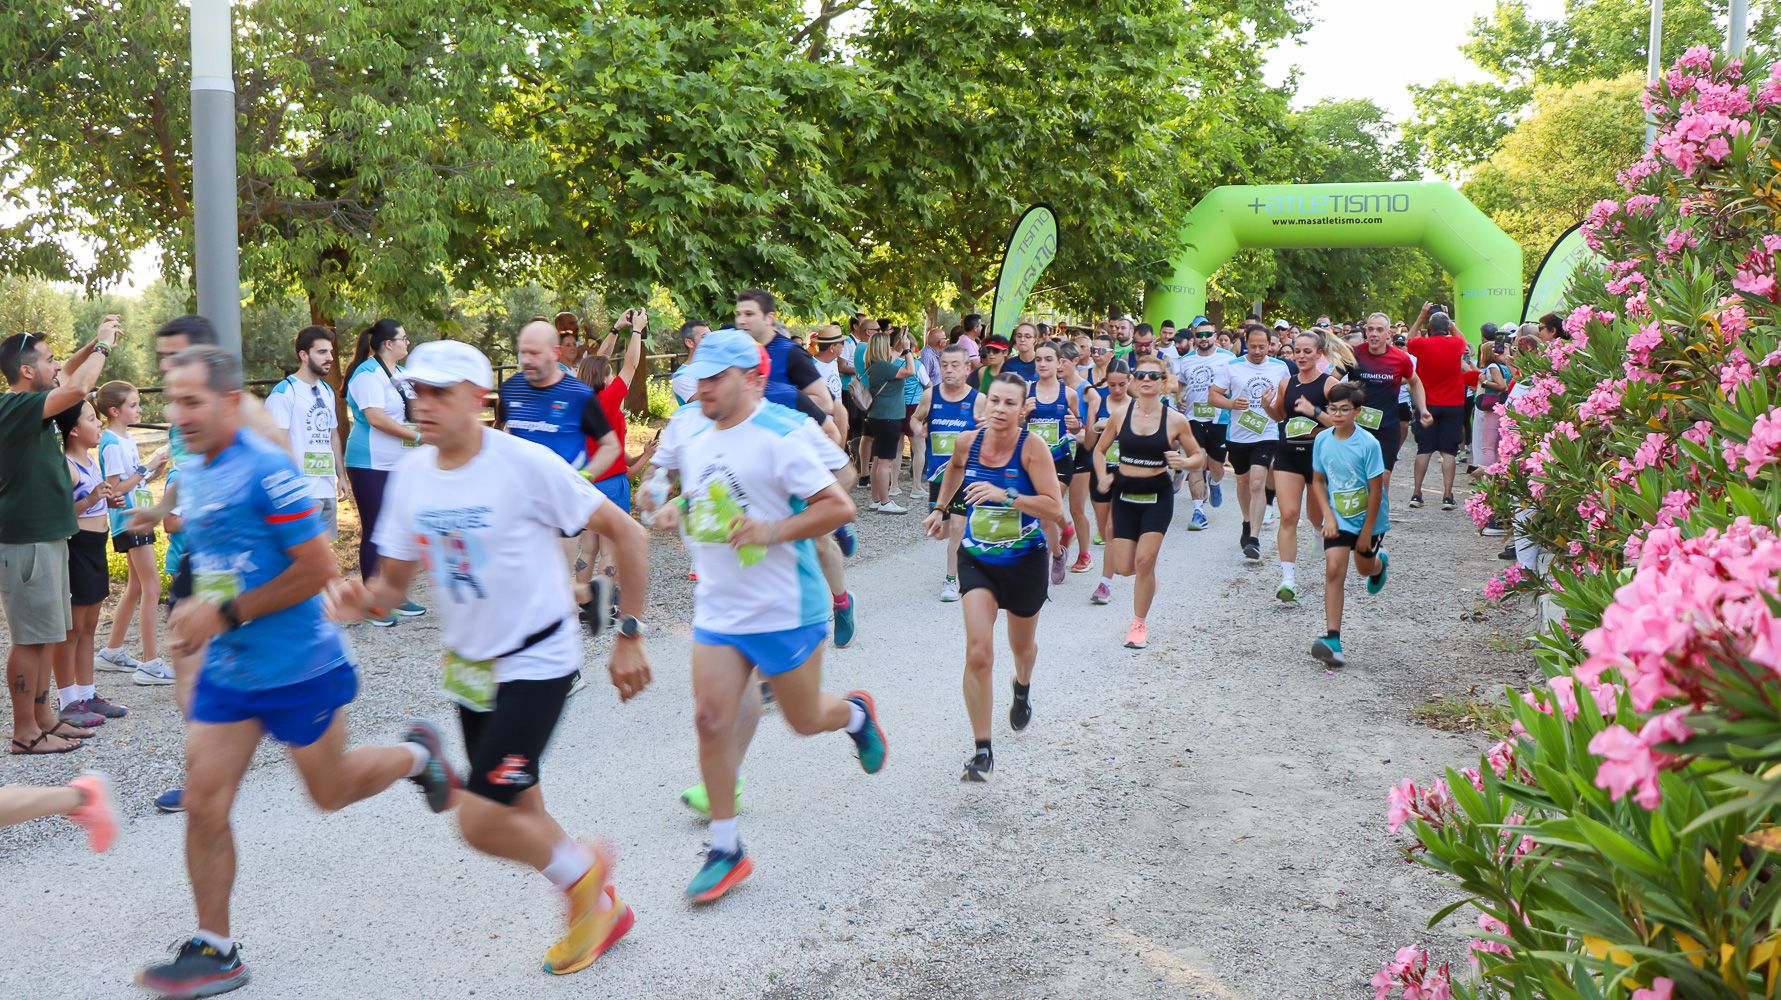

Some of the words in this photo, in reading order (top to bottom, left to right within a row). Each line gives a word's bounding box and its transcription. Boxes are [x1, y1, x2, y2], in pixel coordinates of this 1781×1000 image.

[1272, 216, 1383, 226] www.masatletismo.com
[931, 418, 968, 428] enerplus
[1244, 415, 1263, 428] 365
[940, 439, 948, 449] 9
[309, 459, 331, 469] 704
[1343, 497, 1360, 510] 75
[988, 519, 1001, 533] 7
